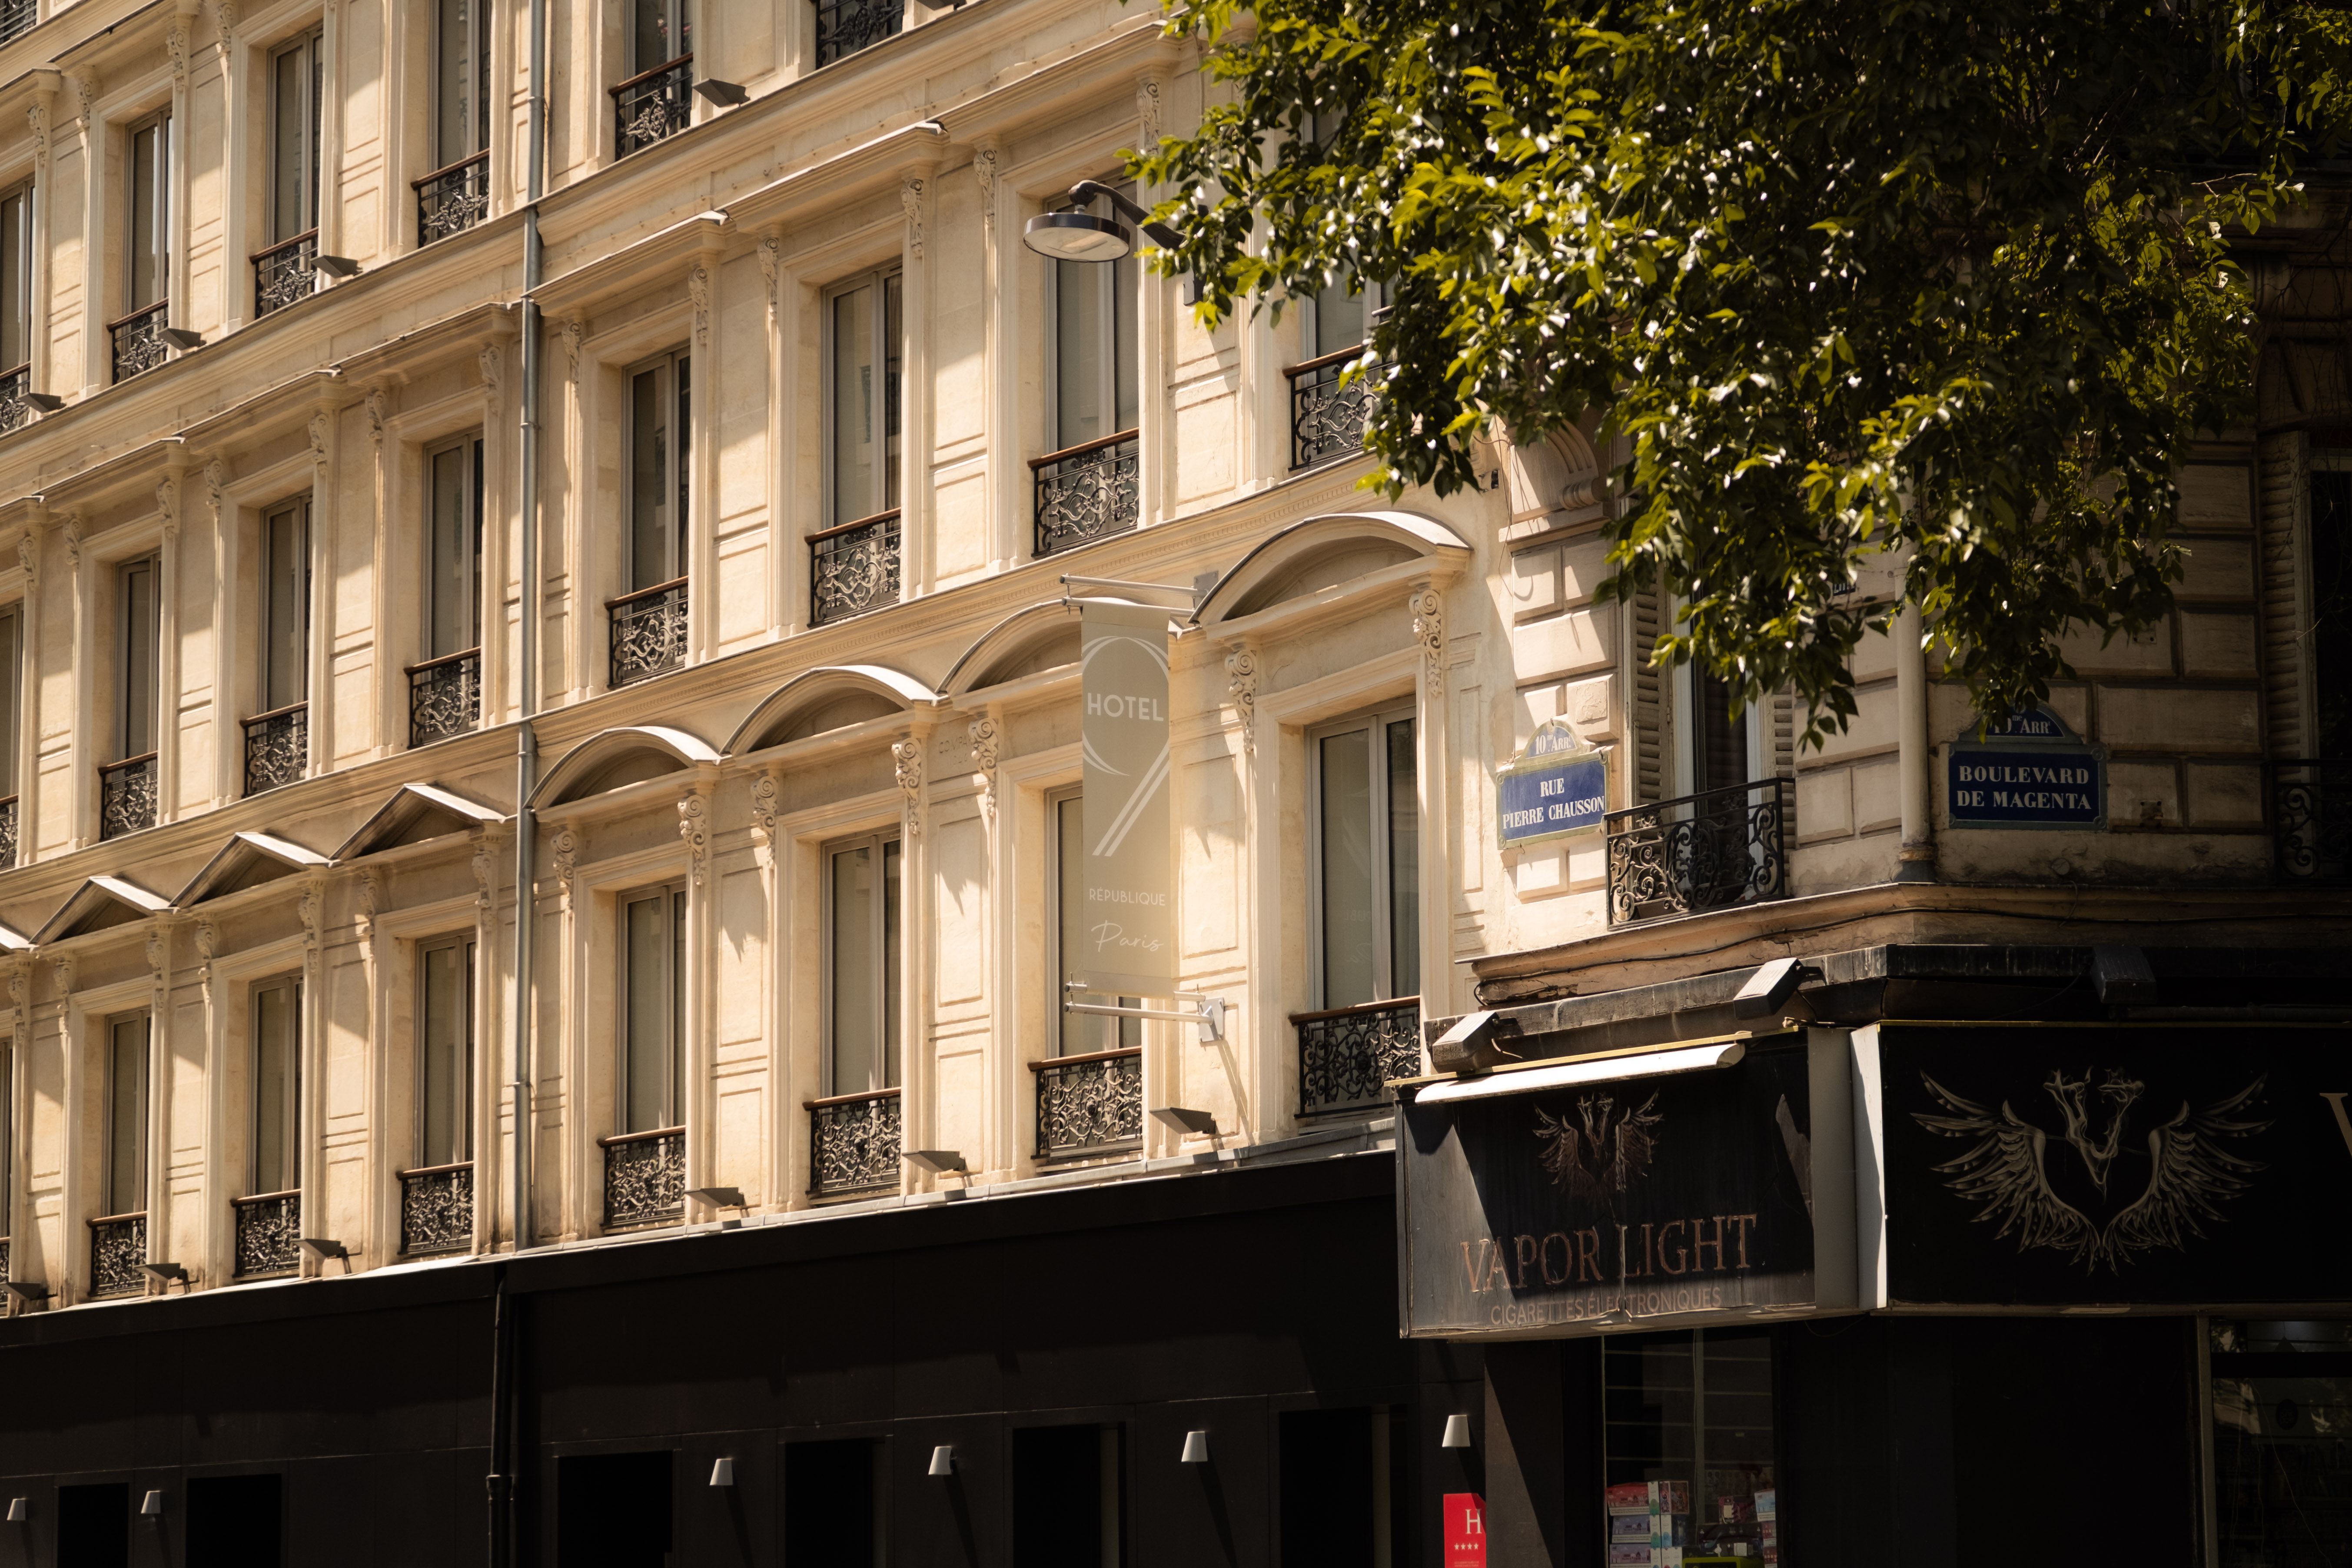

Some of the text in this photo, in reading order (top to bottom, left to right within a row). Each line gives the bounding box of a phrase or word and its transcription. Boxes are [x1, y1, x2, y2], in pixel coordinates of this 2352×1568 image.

[1087, 692, 1164, 721] HOTEL
[1540, 777, 1565, 797] RUE
[1959, 765, 2089, 784] BOULEVARD
[1502, 795, 1605, 829] PIERRE CHAUSSON
[1957, 790, 2092, 809] DE MAGENTA
[1089, 886, 1166, 906] RÉPUBLIQUE
[1090, 919, 1164, 952] Paris
[1460, 1213, 1757, 1292] VAPOR LIGHT
[1491, 1299, 1584, 1325] CIGARETTES
[1465, 1508, 1482, 1534] H
